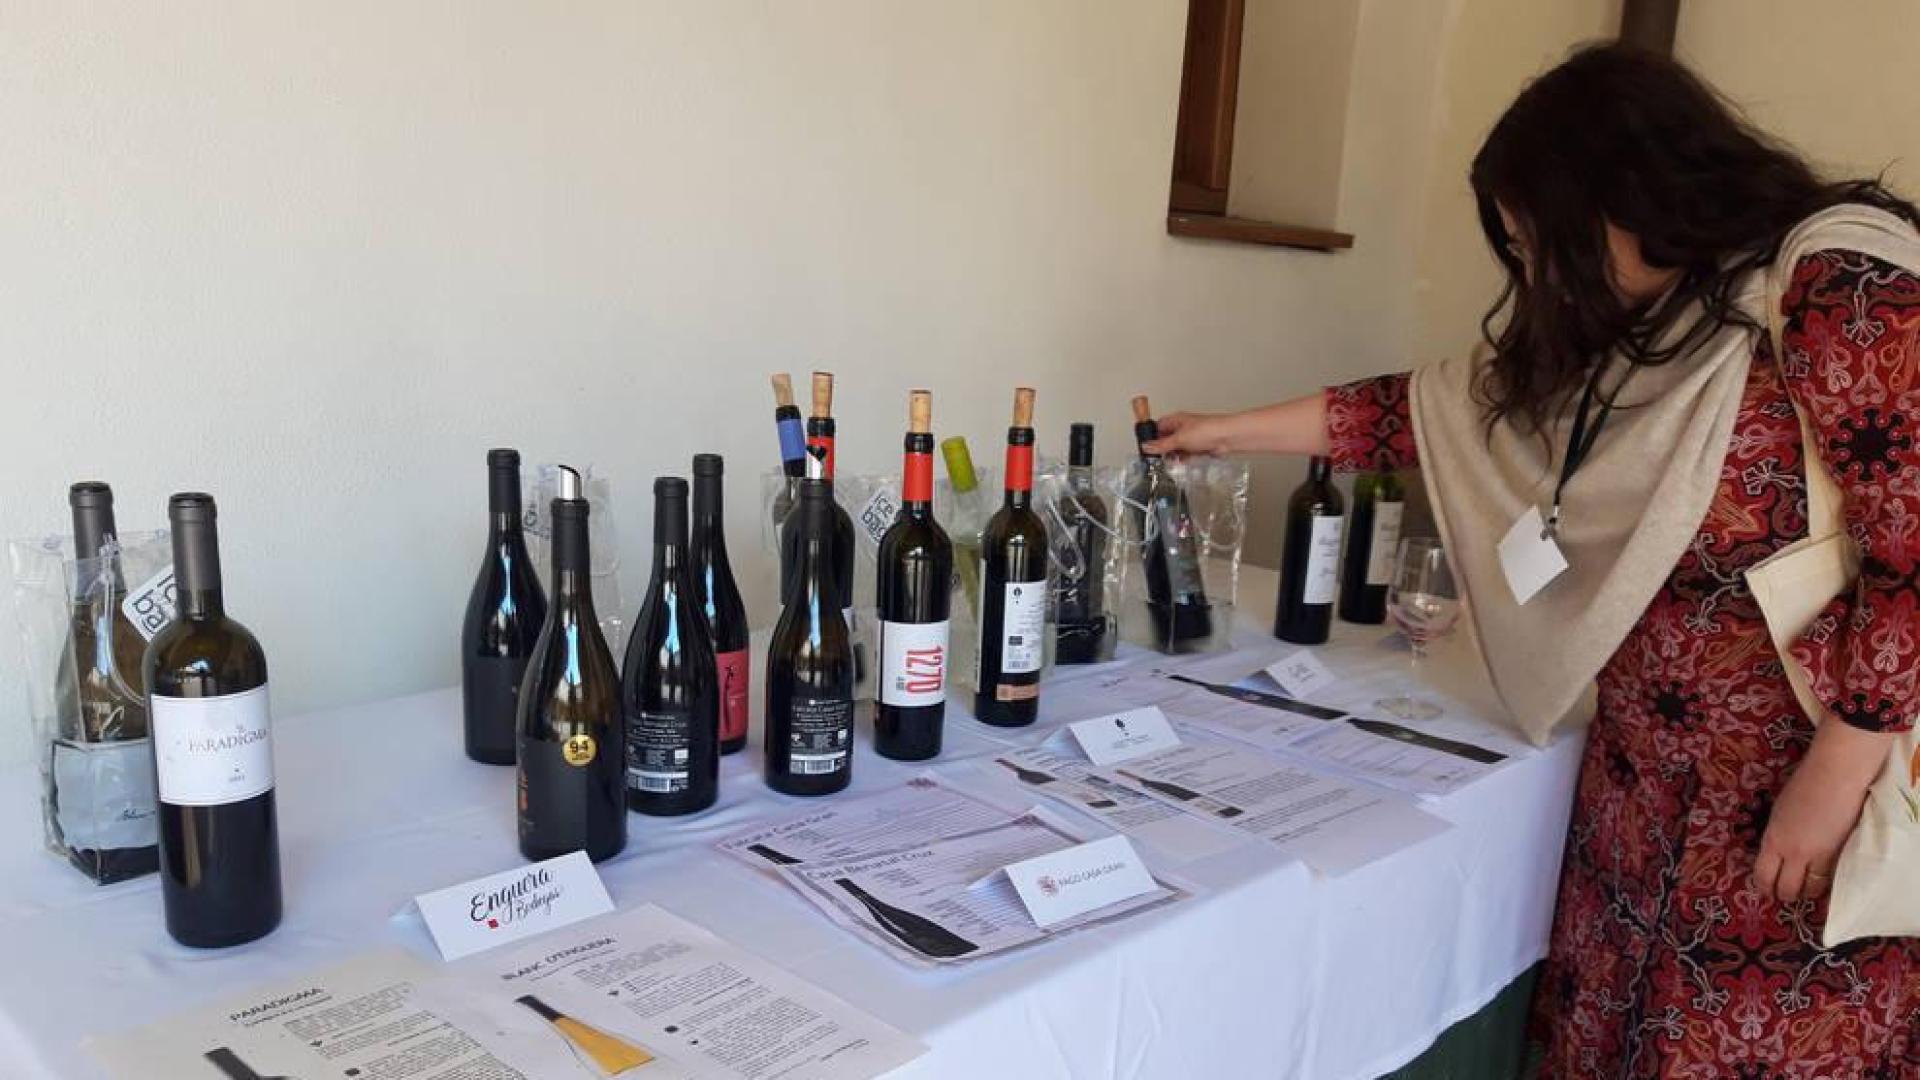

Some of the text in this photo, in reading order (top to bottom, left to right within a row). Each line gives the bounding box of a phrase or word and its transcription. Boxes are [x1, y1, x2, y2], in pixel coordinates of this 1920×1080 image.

[906, 645, 943, 693] 1270
[569, 740, 589, 754] 94
[470, 868, 554, 923] Enguera
[229, 987, 323, 1021] PARADIGMA
